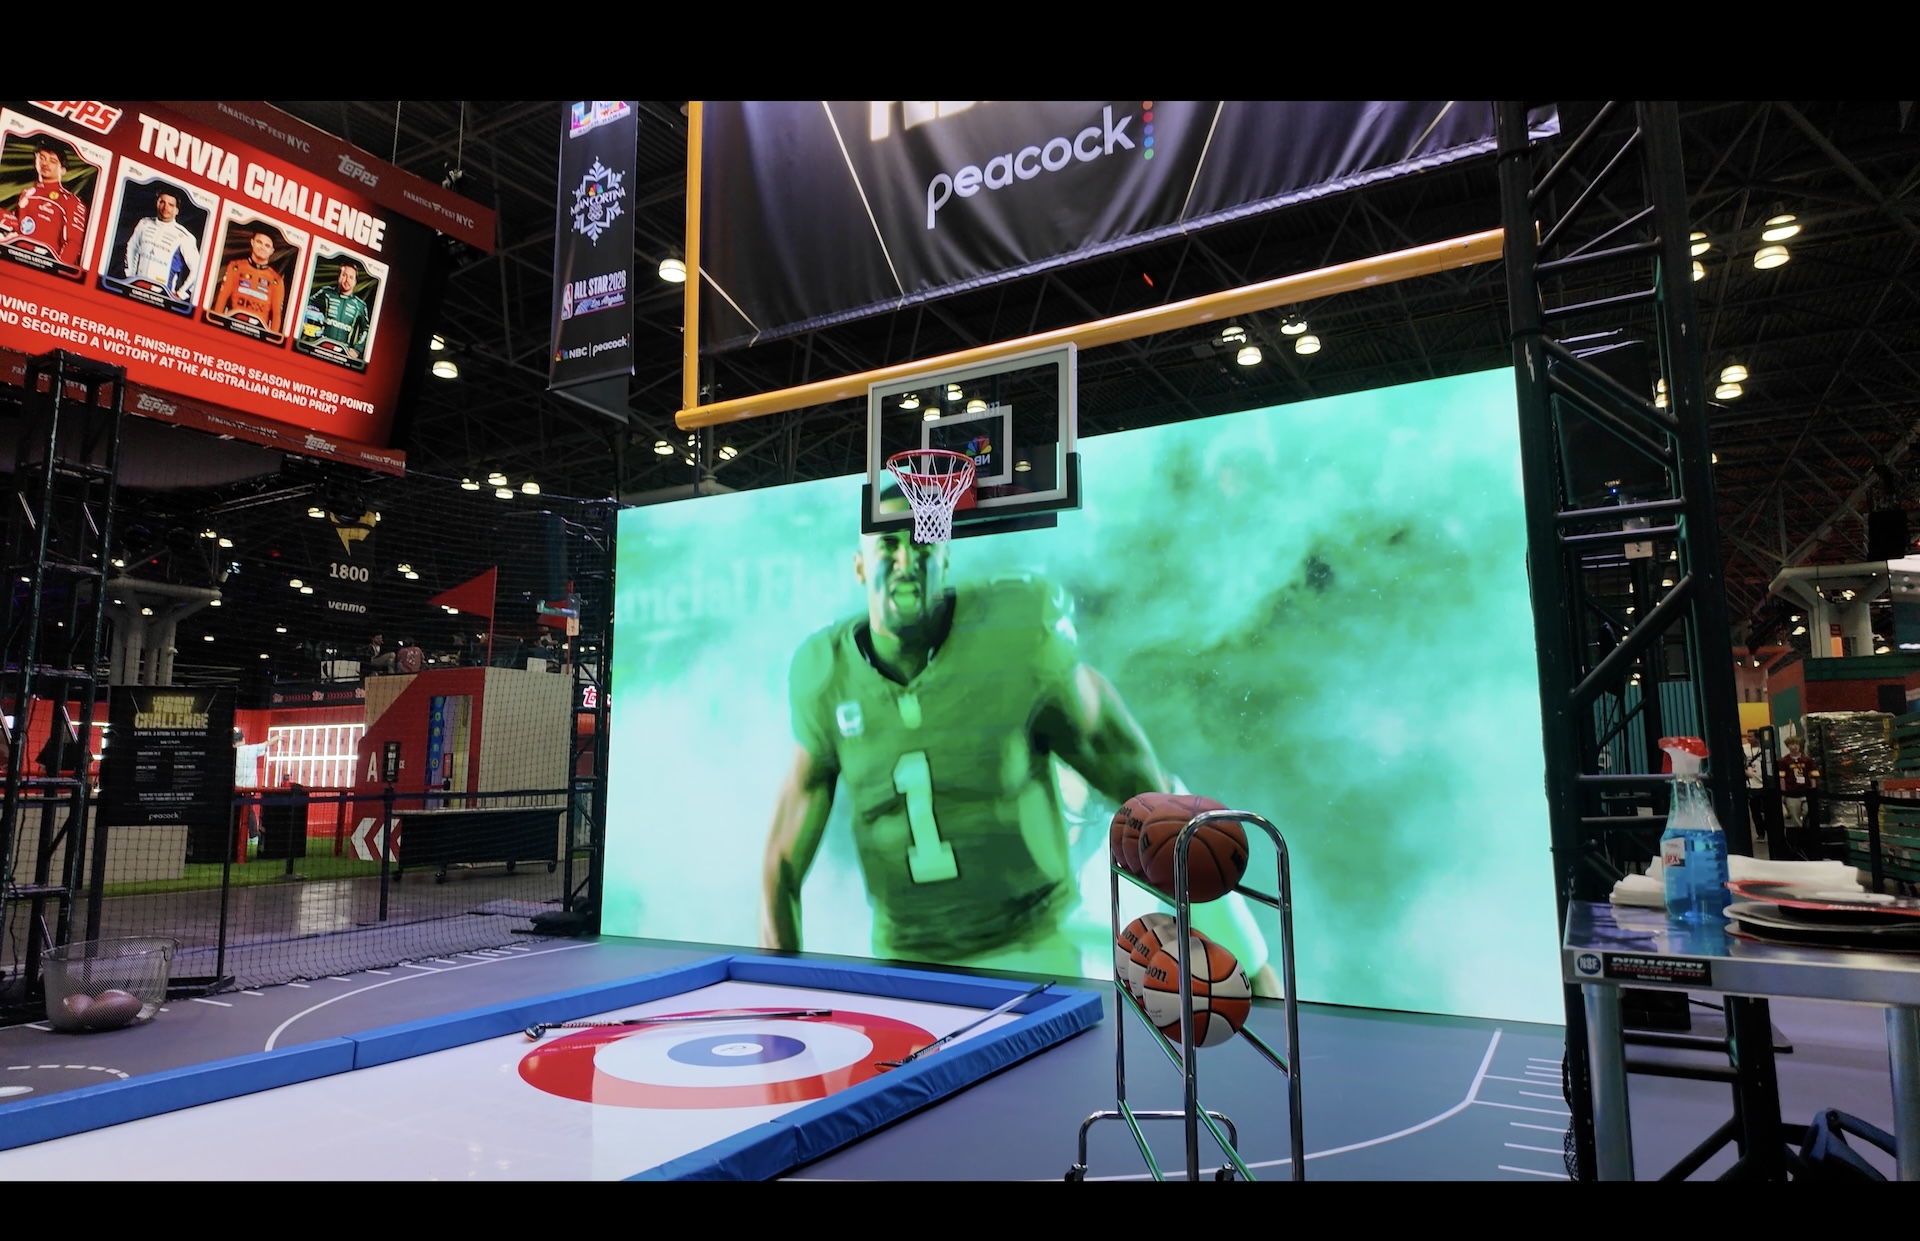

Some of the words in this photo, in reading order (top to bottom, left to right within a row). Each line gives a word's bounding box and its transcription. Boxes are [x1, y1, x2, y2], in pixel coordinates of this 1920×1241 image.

[217, 102, 257, 126] FANATICS
[267, 126, 286, 141] FEST
[286, 133, 310, 153] NYC
[138, 112, 240, 191] TRIVIA
[243, 162, 387, 252] CHALLENGE
[927, 105, 1136, 230] peacock
[403, 189, 433, 211] FANATICS
[456, 213, 474, 229] NYC
[574, 280, 588, 300] ALL
[588, 275, 608, 297] STAR
[608, 269, 627, 292] 2026
[0, 309, 19, 325] ND
[21, 316, 88, 344] SECURED
[90, 338, 100, 349] A
[103, 339, 158, 365] VICTORY
[159, 356, 175, 369] AT
[177, 363, 198, 376] THE
[200, 367, 269, 397] AUSTRALIAN
[271, 387, 307, 407] GRAND
[308, 399, 337, 415] PRIX?
[41, 306, 70, 325] FOR
[72, 316, 131, 345] FERRARI,
[134, 334, 191, 359] FINISHED
[193, 352, 214, 368] THE
[217, 358, 246, 379] 2024
[247, 368, 291, 390] SEASON
[292, 381, 318, 397] WITH
[319, 389, 339, 404] 290
[340, 396, 375, 414] POINTS
[569, 347, 588, 359] NBC
[593, 335, 627, 357] peacock
[330, 562, 369, 583] 1800
[328, 600, 367, 614] venmo
[134, 713, 209, 729] CHALLENGE
[149, 812, 180, 822] peacock
[893, 751, 958, 883] 1
[1579, 957, 1598, 970] NSF
